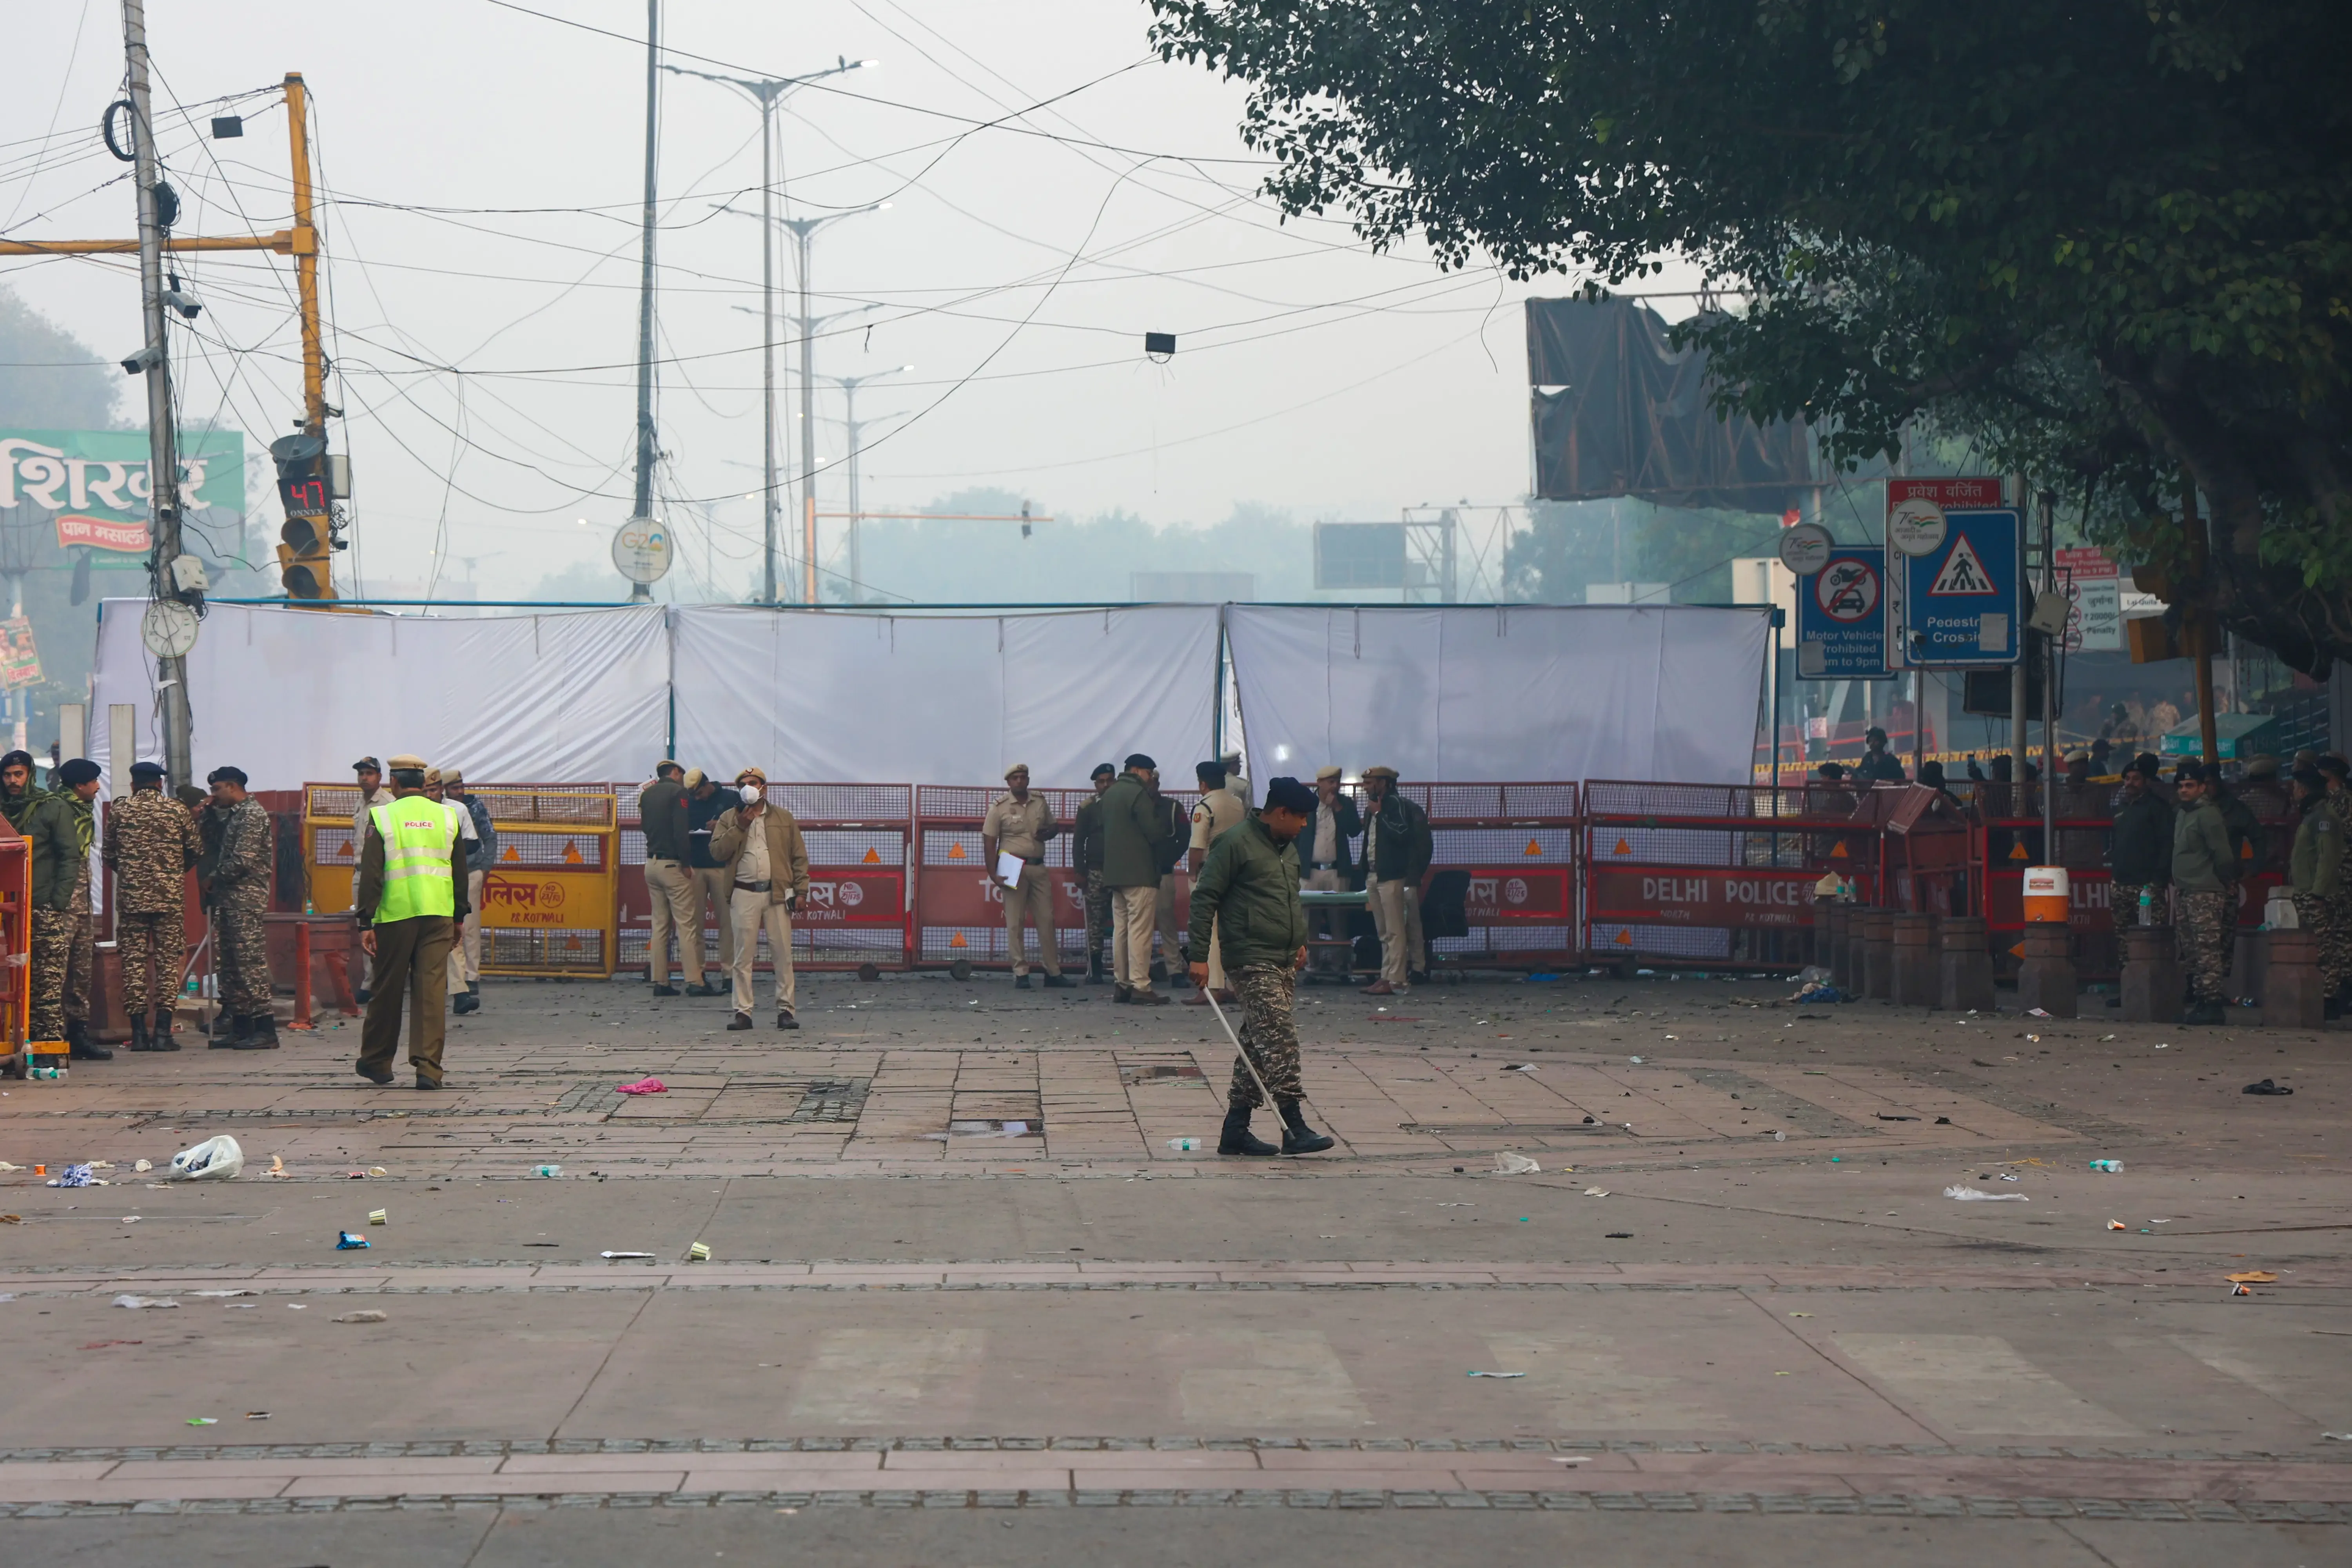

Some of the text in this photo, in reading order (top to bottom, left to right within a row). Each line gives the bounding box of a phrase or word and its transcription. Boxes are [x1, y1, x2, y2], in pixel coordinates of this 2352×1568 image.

[291, 481, 325, 508] 47
[1907, 482, 1982, 497] प्रवेश वर्जित
[1934, 500, 1997, 509] rohibited
[62, 522, 145, 544] पान मसाला
[1927, 617, 1980, 628] Pedestr
[1806, 630, 1839, 640] Motor
[2087, 626, 2116, 635] Penalty
[1933, 632, 1980, 642] Crossi
[1842, 657, 1853, 666] to
[1856, 657, 1880, 668] 9pm
[1643, 878, 1708, 902] DELHI
[1725, 880, 1799, 906] POLICE
[523, 912, 564, 923] KOTWALI
[807, 909, 846, 920] KOTWALI
[1660, 909, 1690, 920] NORTH
